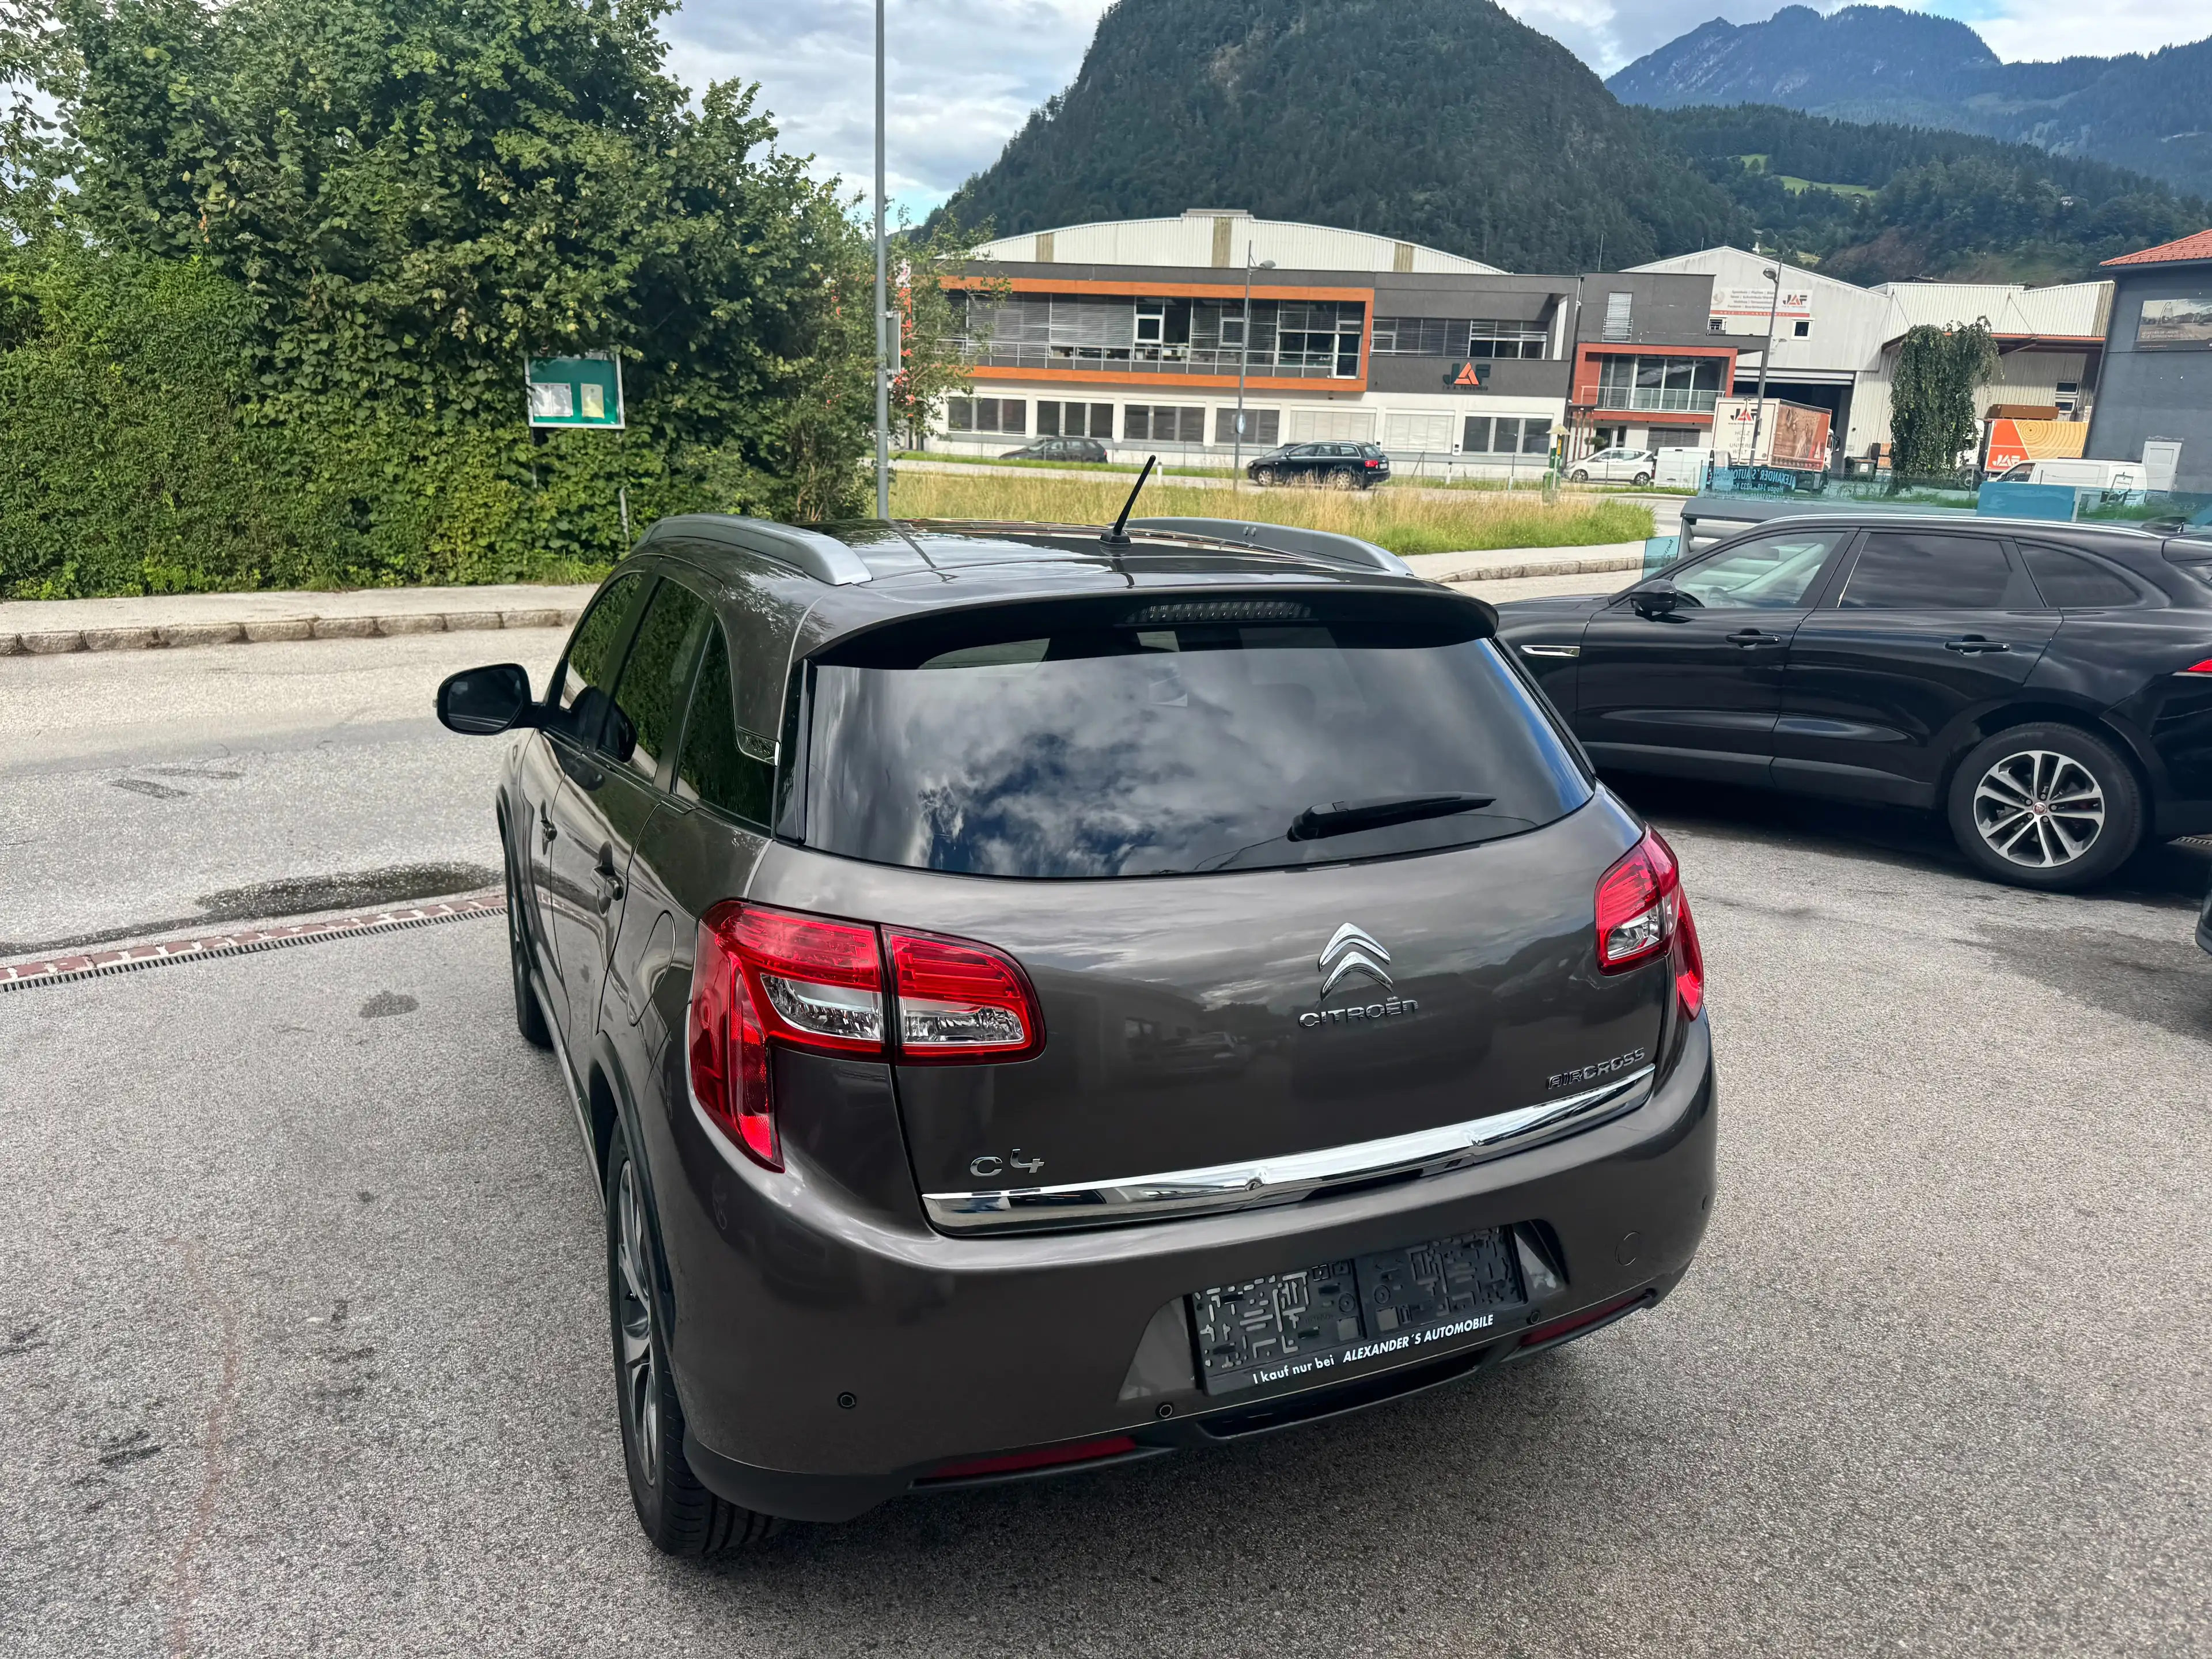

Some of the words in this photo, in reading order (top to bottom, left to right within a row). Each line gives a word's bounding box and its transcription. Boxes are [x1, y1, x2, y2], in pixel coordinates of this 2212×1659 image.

[1782, 294, 1808, 305] JAF
[1442, 362, 1491, 385] JAF
[1547, 1047, 1645, 1090] AIRCROSS
[1260, 1365, 1289, 1382] kauf
[1292, 1363, 1313, 1374] nur
[1315, 1354, 1335, 1369] bei
[1424, 1314, 1494, 1343] AUTOMOBILE
